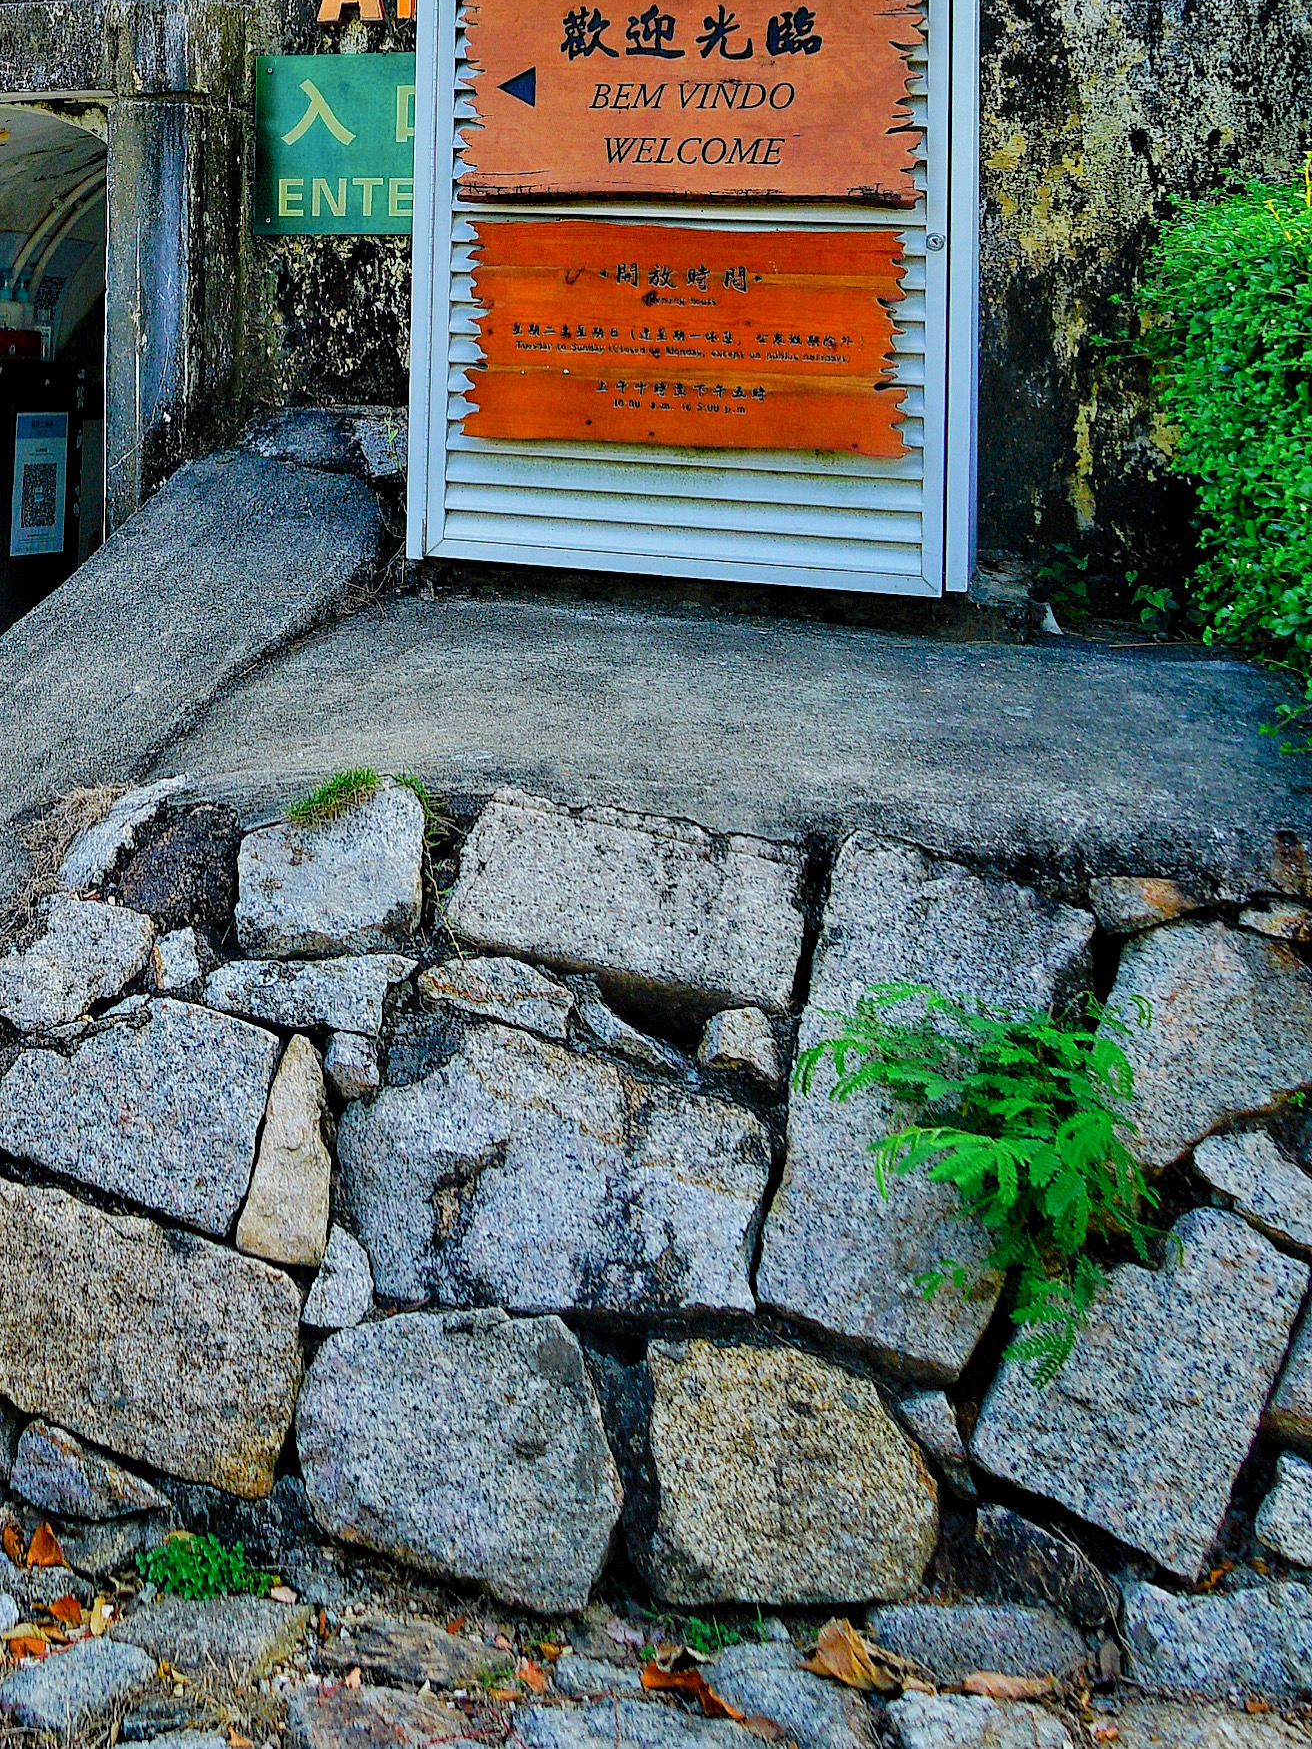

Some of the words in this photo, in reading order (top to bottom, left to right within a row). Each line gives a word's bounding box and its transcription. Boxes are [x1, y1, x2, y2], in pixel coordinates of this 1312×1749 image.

[560, 5, 823, 61] 歡迎光臨
[589, 83, 663, 110] BEM
[677, 83, 795, 110] VINDO
[603, 137, 786, 165] WELCOME
[616, 263, 748, 294] 開放時間
